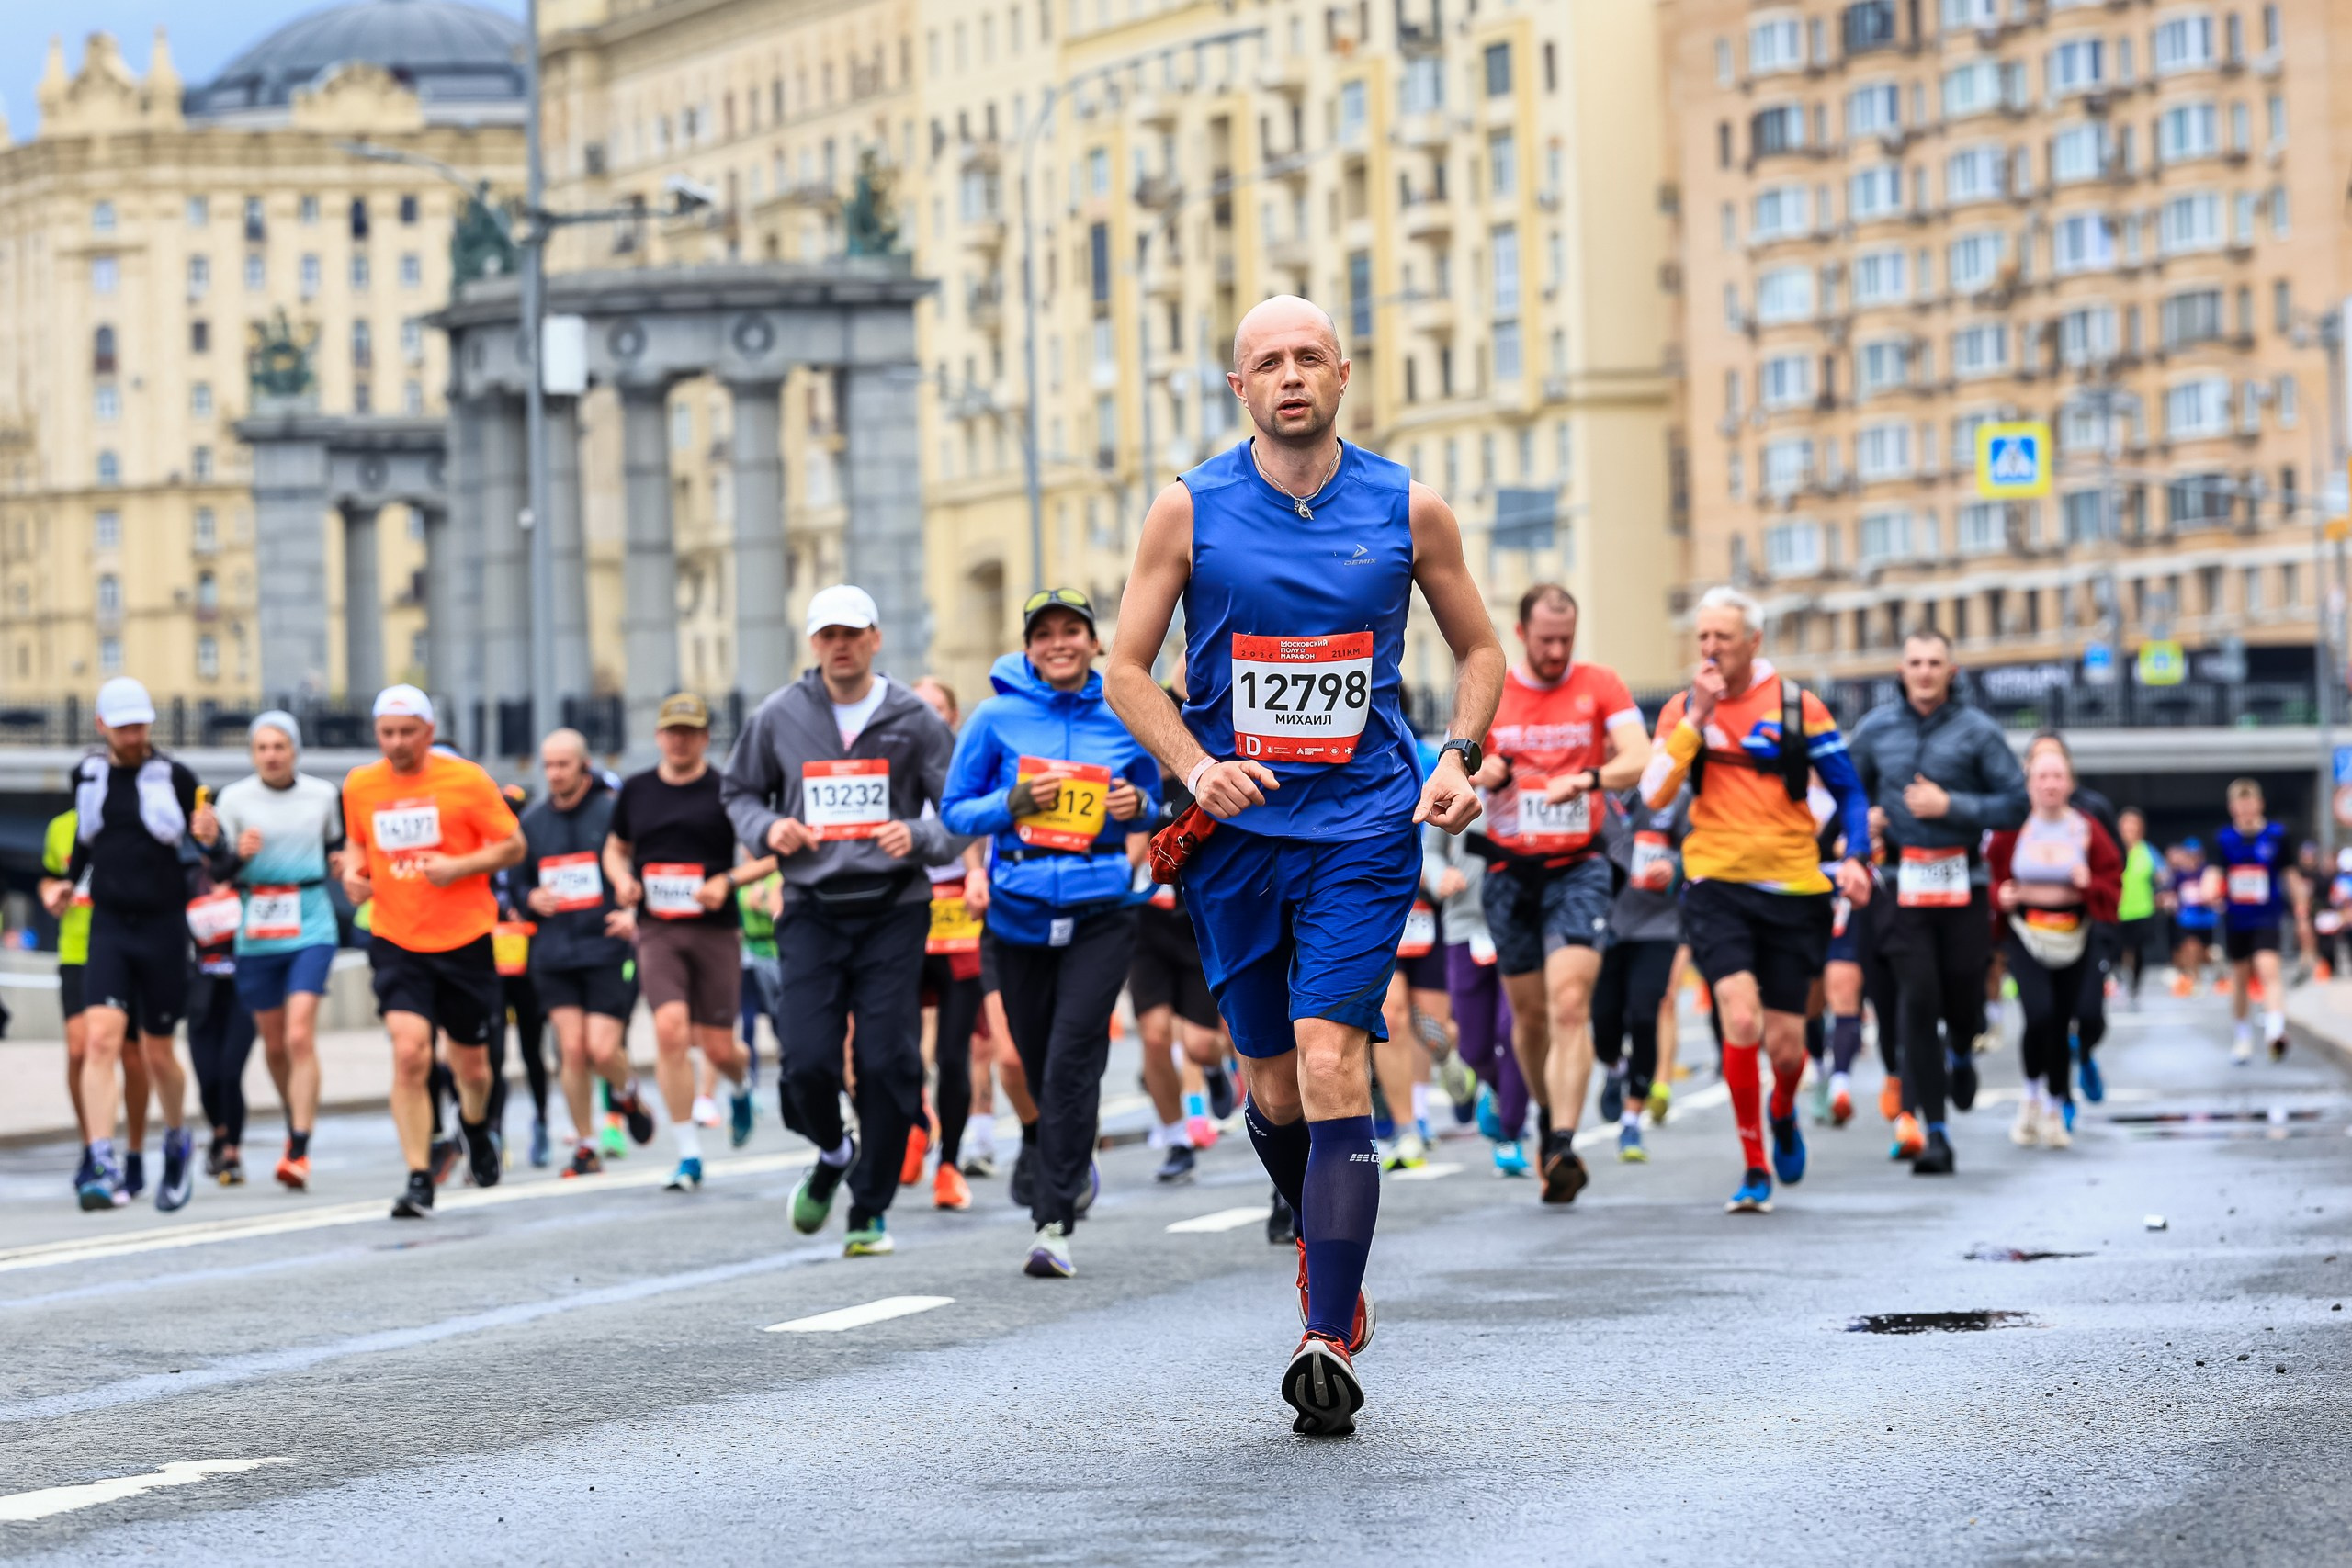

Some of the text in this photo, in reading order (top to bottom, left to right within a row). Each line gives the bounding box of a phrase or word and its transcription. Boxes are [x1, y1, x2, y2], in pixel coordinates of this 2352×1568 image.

[1241, 650, 1273, 659] 2026
[1240, 671, 1367, 712] 12798
[1275, 714, 1332, 726] МИХАИЛ
[1246, 736, 1261, 756] D
[811, 783, 884, 807] 13232
